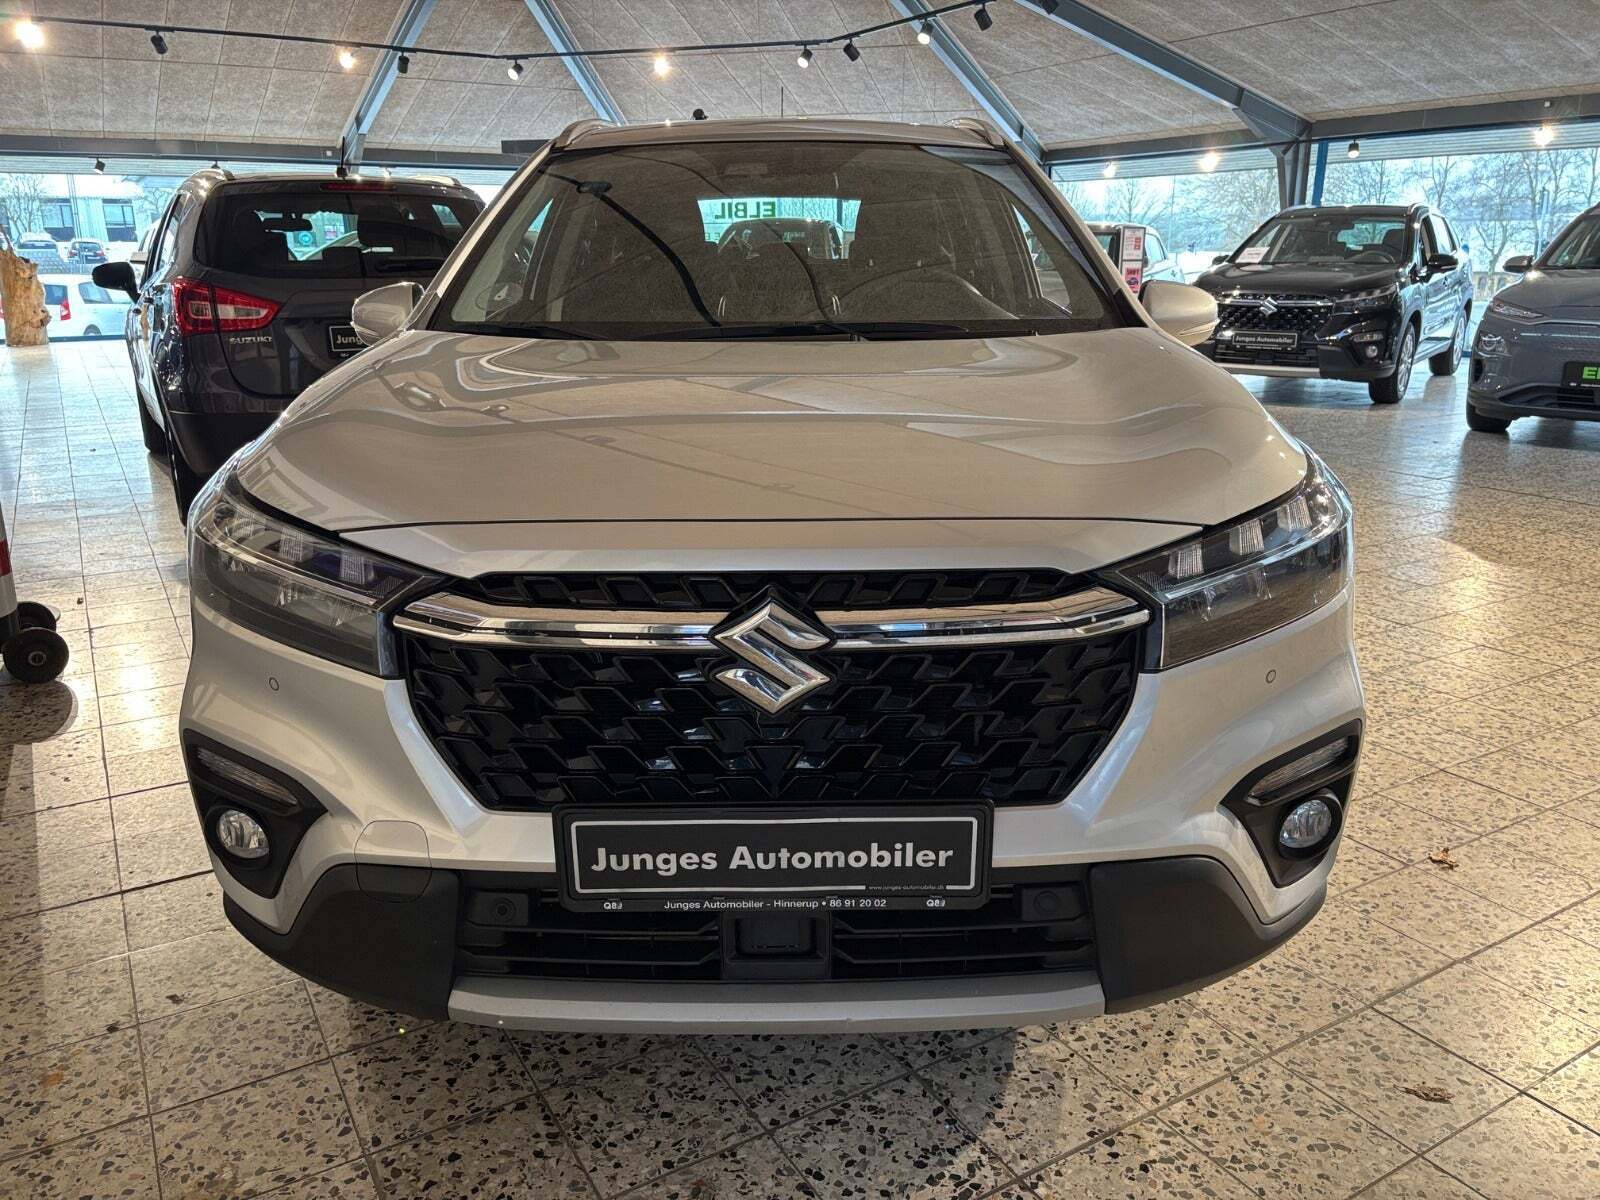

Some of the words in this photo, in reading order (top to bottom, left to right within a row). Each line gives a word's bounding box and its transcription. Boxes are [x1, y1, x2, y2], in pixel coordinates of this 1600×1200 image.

[229, 336, 273, 345] SUZUKI
[336, 334, 362, 346] Jung
[591, 847, 718, 877] Junges
[729, 842, 953, 870] Automobiler
[664, 901, 700, 912] Junges
[703, 900, 764, 910] Automobiler
[774, 900, 818, 909] Hinnerup
[829, 899, 841, 908] 86
[844, 899, 856, 908] 91
[859, 899, 872, 908] 20
[874, 899, 887, 908] 02
